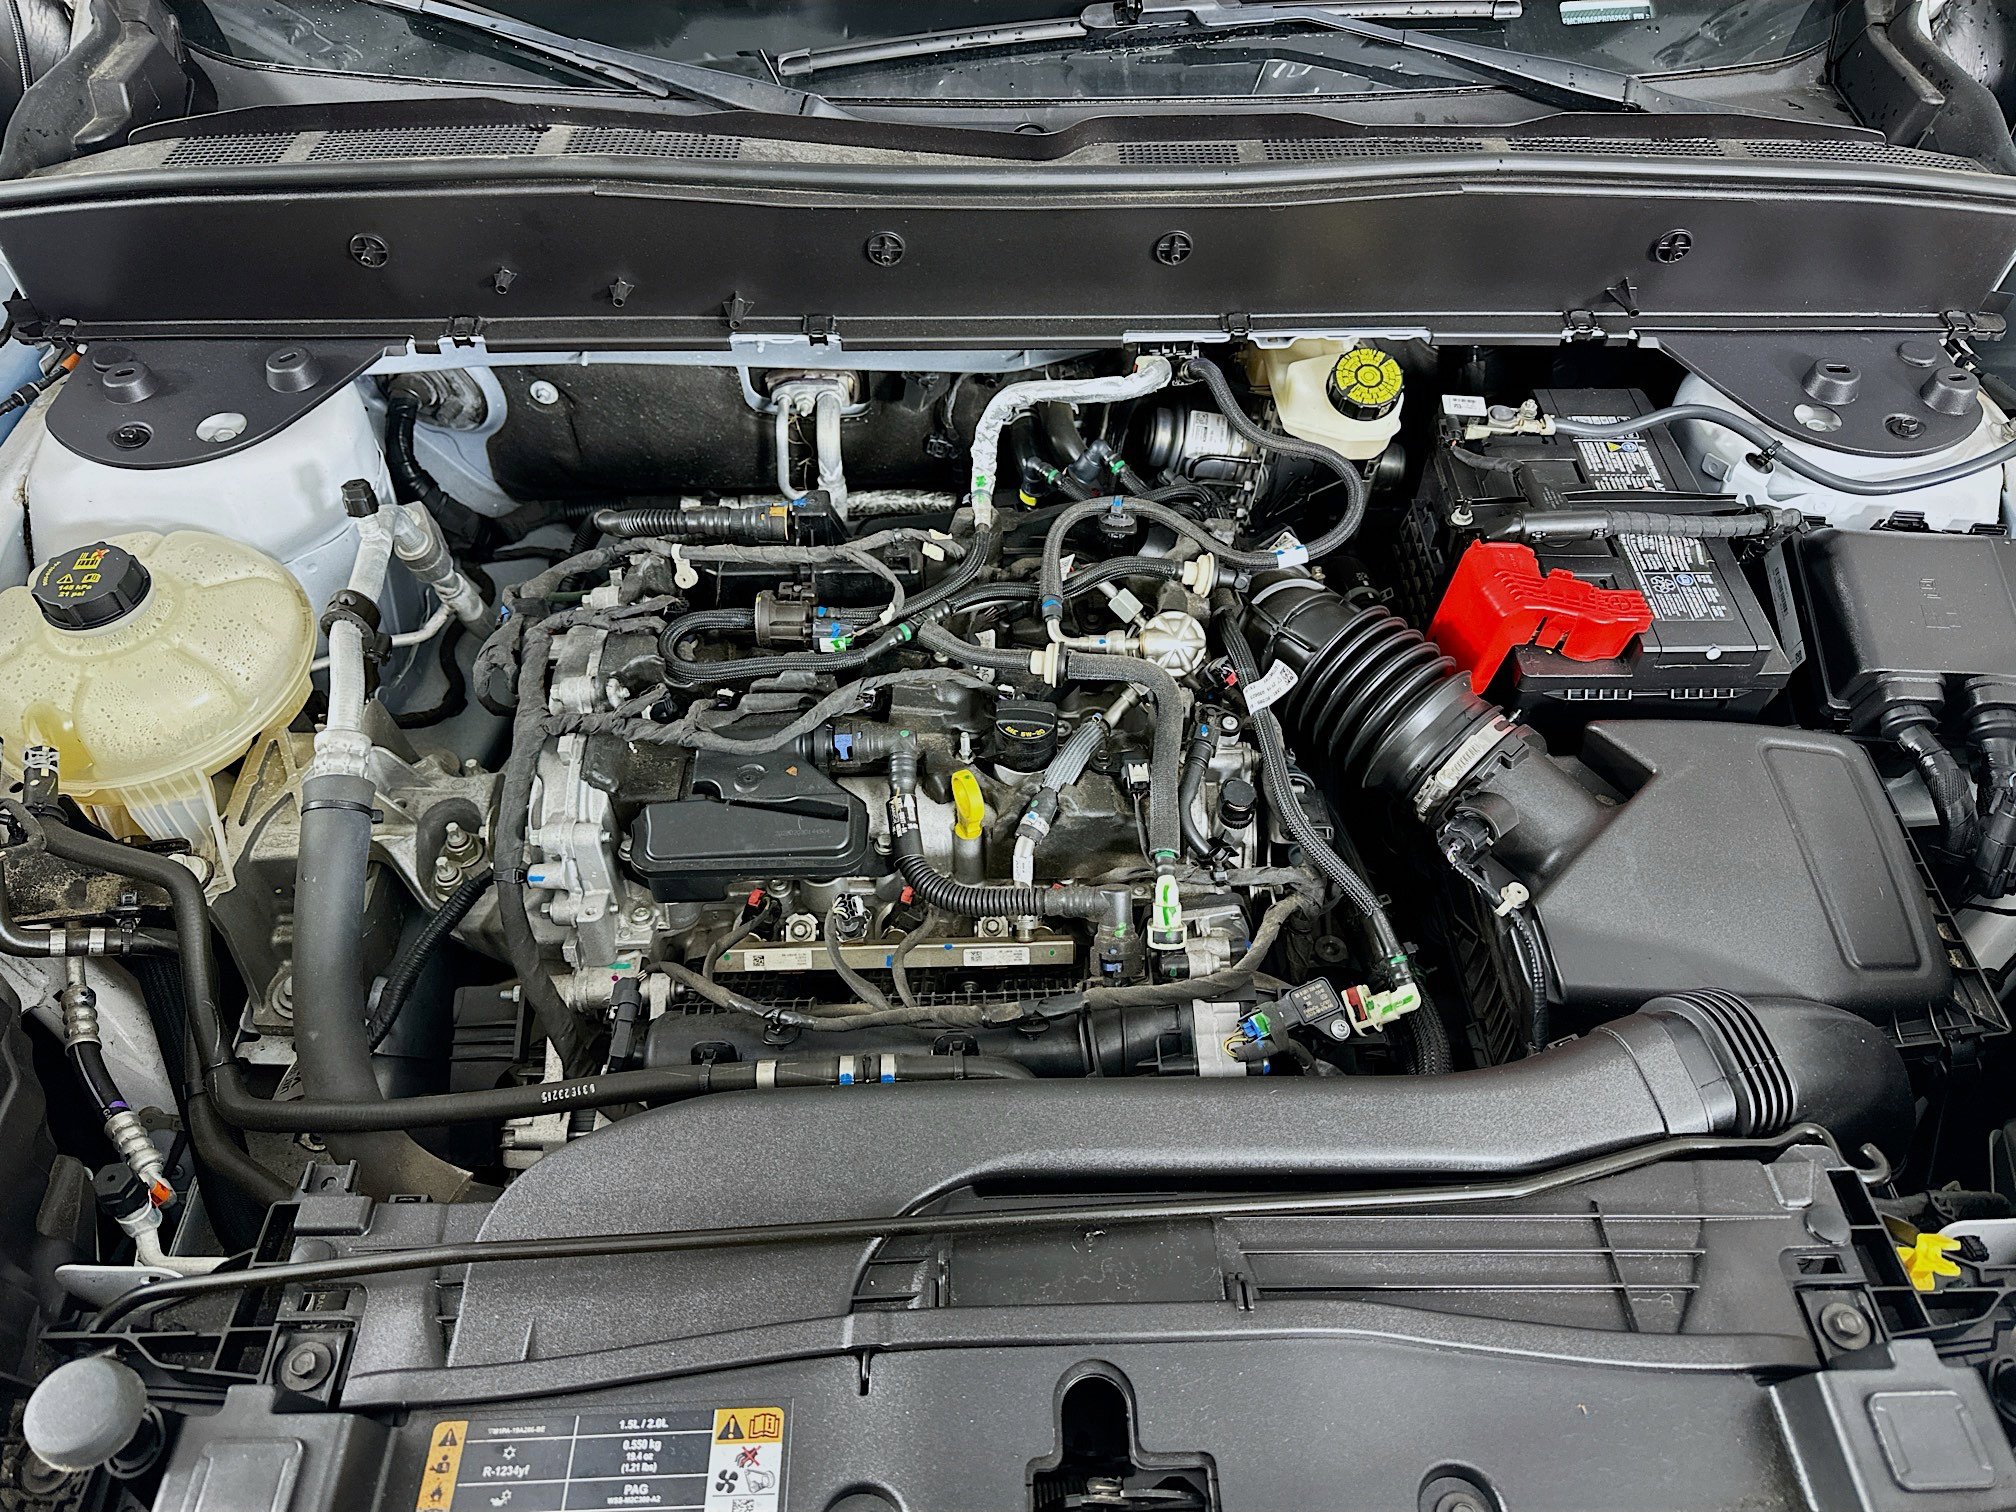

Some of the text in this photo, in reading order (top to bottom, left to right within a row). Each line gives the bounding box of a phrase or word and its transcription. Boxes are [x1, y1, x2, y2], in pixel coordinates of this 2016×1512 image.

[619, 1418, 640, 1430] 1.5L
[646, 1417, 669, 1429] 2.0L
[622, 1438, 662, 1452] 0.550 kg
[626, 1451, 643, 1461] 19.4
[482, 1464, 531, 1478] R-1234yf
[623, 1483, 650, 1496] PAG
